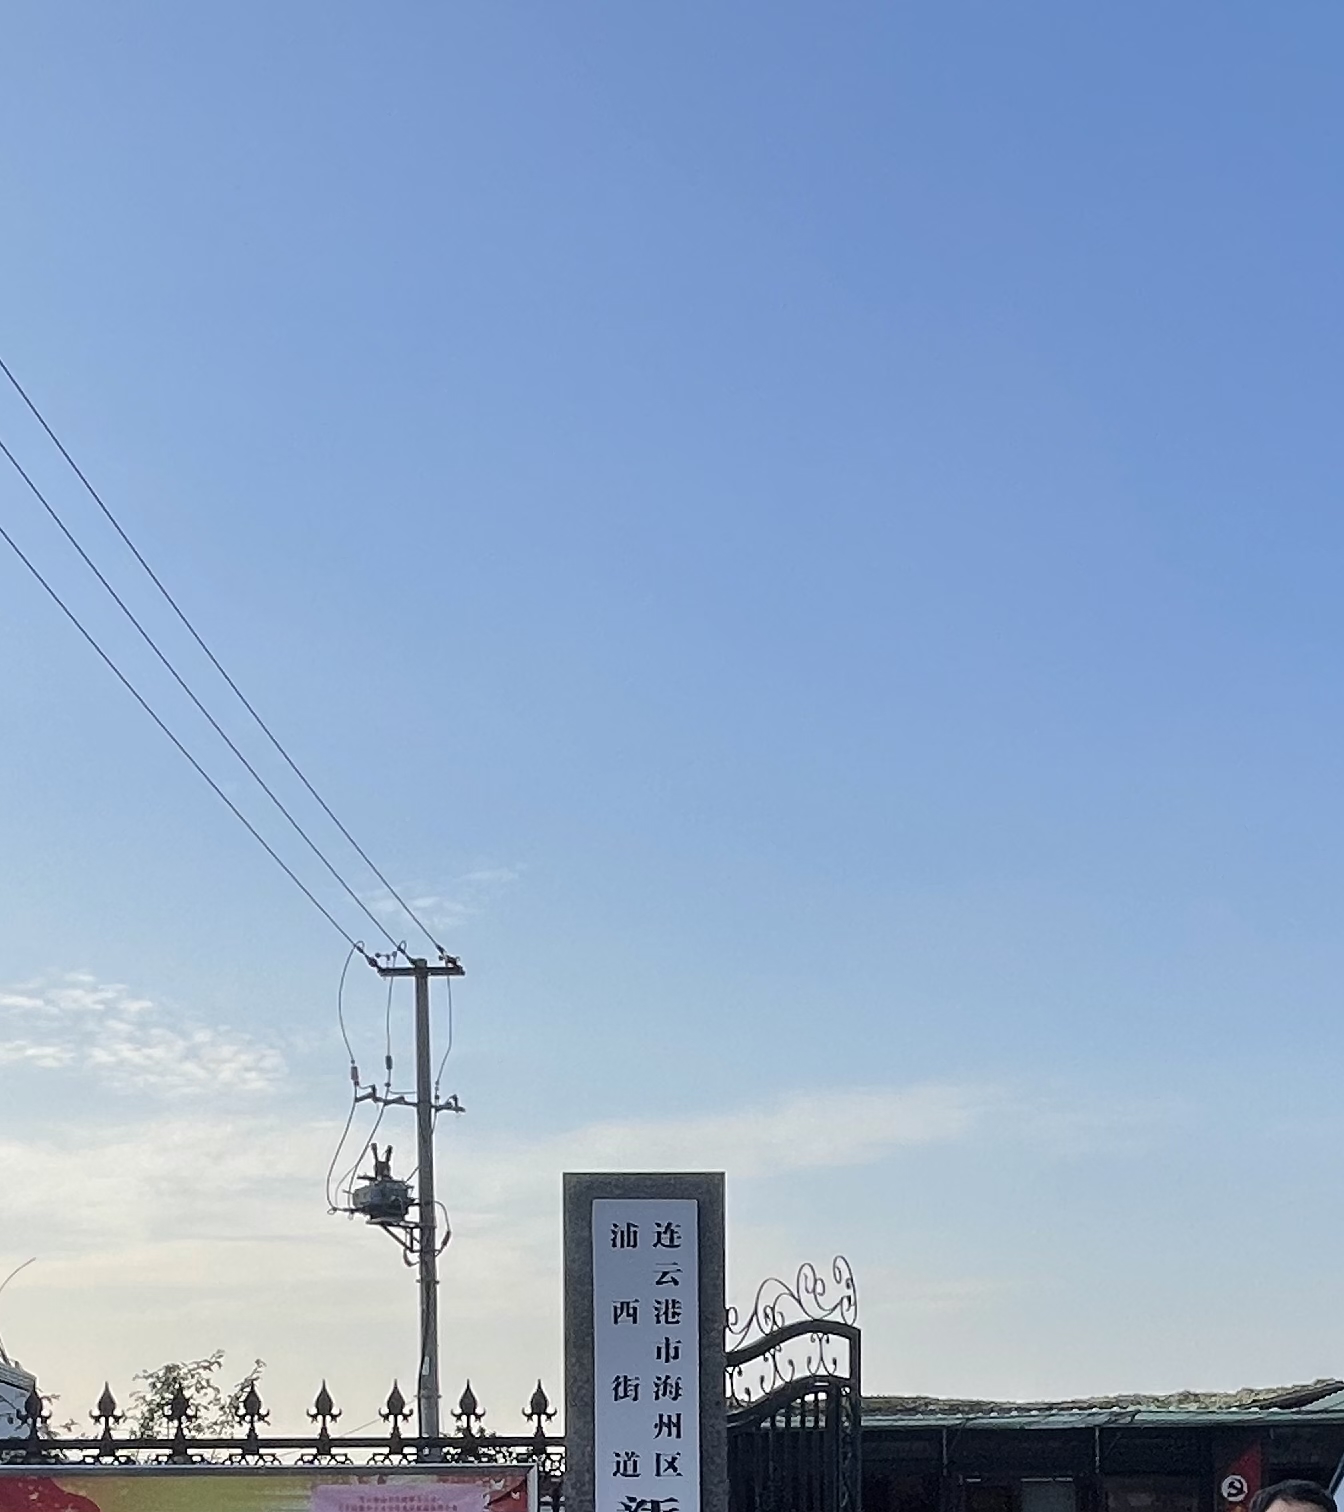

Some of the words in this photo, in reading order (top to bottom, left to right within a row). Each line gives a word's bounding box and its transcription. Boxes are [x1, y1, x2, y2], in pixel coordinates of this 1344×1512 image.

[611, 1222, 642, 1478] 浦西街道
[652, 1222, 683, 1478] 连云港市海州区
